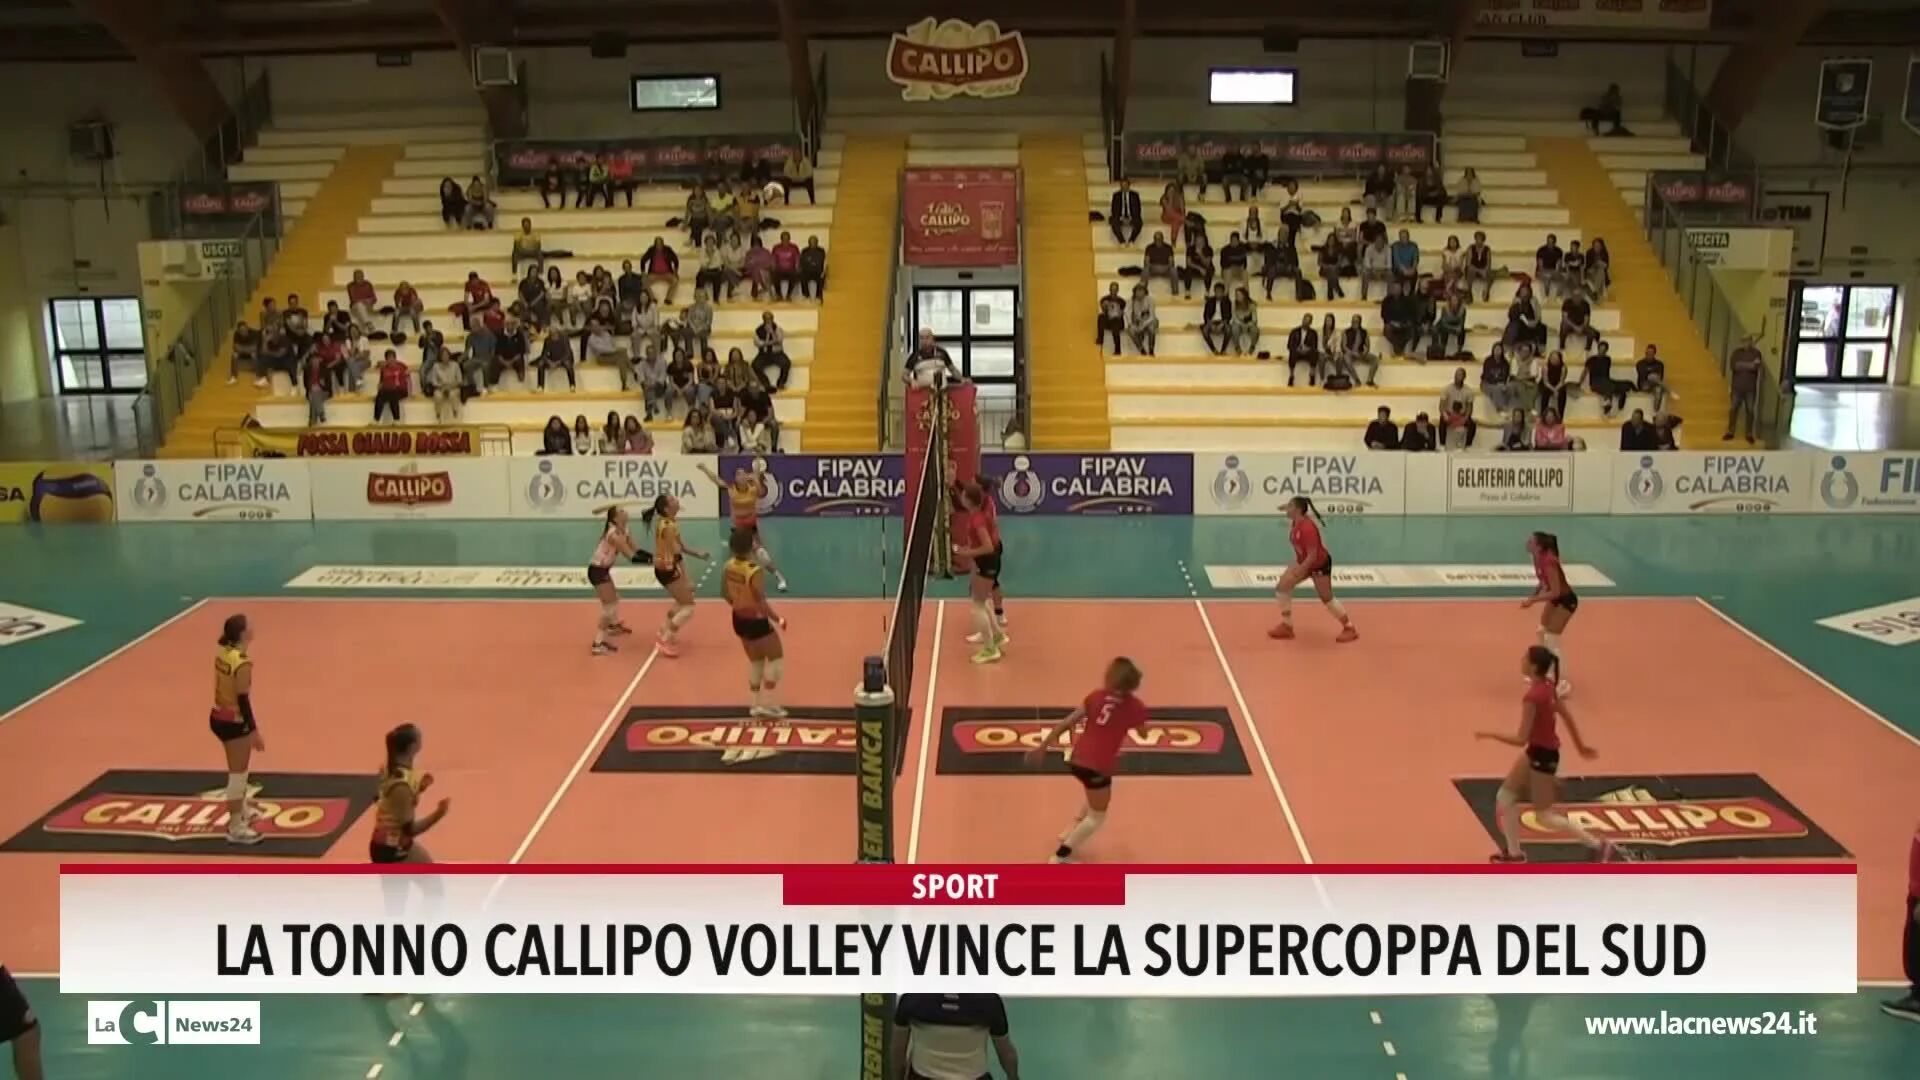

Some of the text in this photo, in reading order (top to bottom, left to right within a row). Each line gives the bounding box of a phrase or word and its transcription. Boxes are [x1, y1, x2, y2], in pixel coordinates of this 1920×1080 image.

[902, 48, 1014, 75] CALLIPO
[920, 214, 970, 226] CALLIPO
[204, 463, 265, 482] FIPAV
[604, 460, 669, 479] FIPAV
[818, 459, 883, 478] FIPAV
[1081, 457, 1146, 476] FIPAV
[1292, 456, 1357, 474] FIPAV
[1703, 456, 1765, 474] FIPAV
[1052, 477, 1174, 496] CALABRIA
[1263, 475, 1383, 495] CALABRIA
[1457, 467, 1564, 488] GELATERIA CALLIPO
[1675, 475, 1790, 494] CALABRIA
[179, 483, 290, 501] CALABRIA
[374, 479, 446, 497] CALLIPO
[576, 480, 697, 498] CALABRIA
[789, 479, 905, 498] CALABRIA
[1096, 703, 1114, 726] 5
[646, 725, 857, 746] CALLIPO
[861, 720, 883, 809] BANCA
